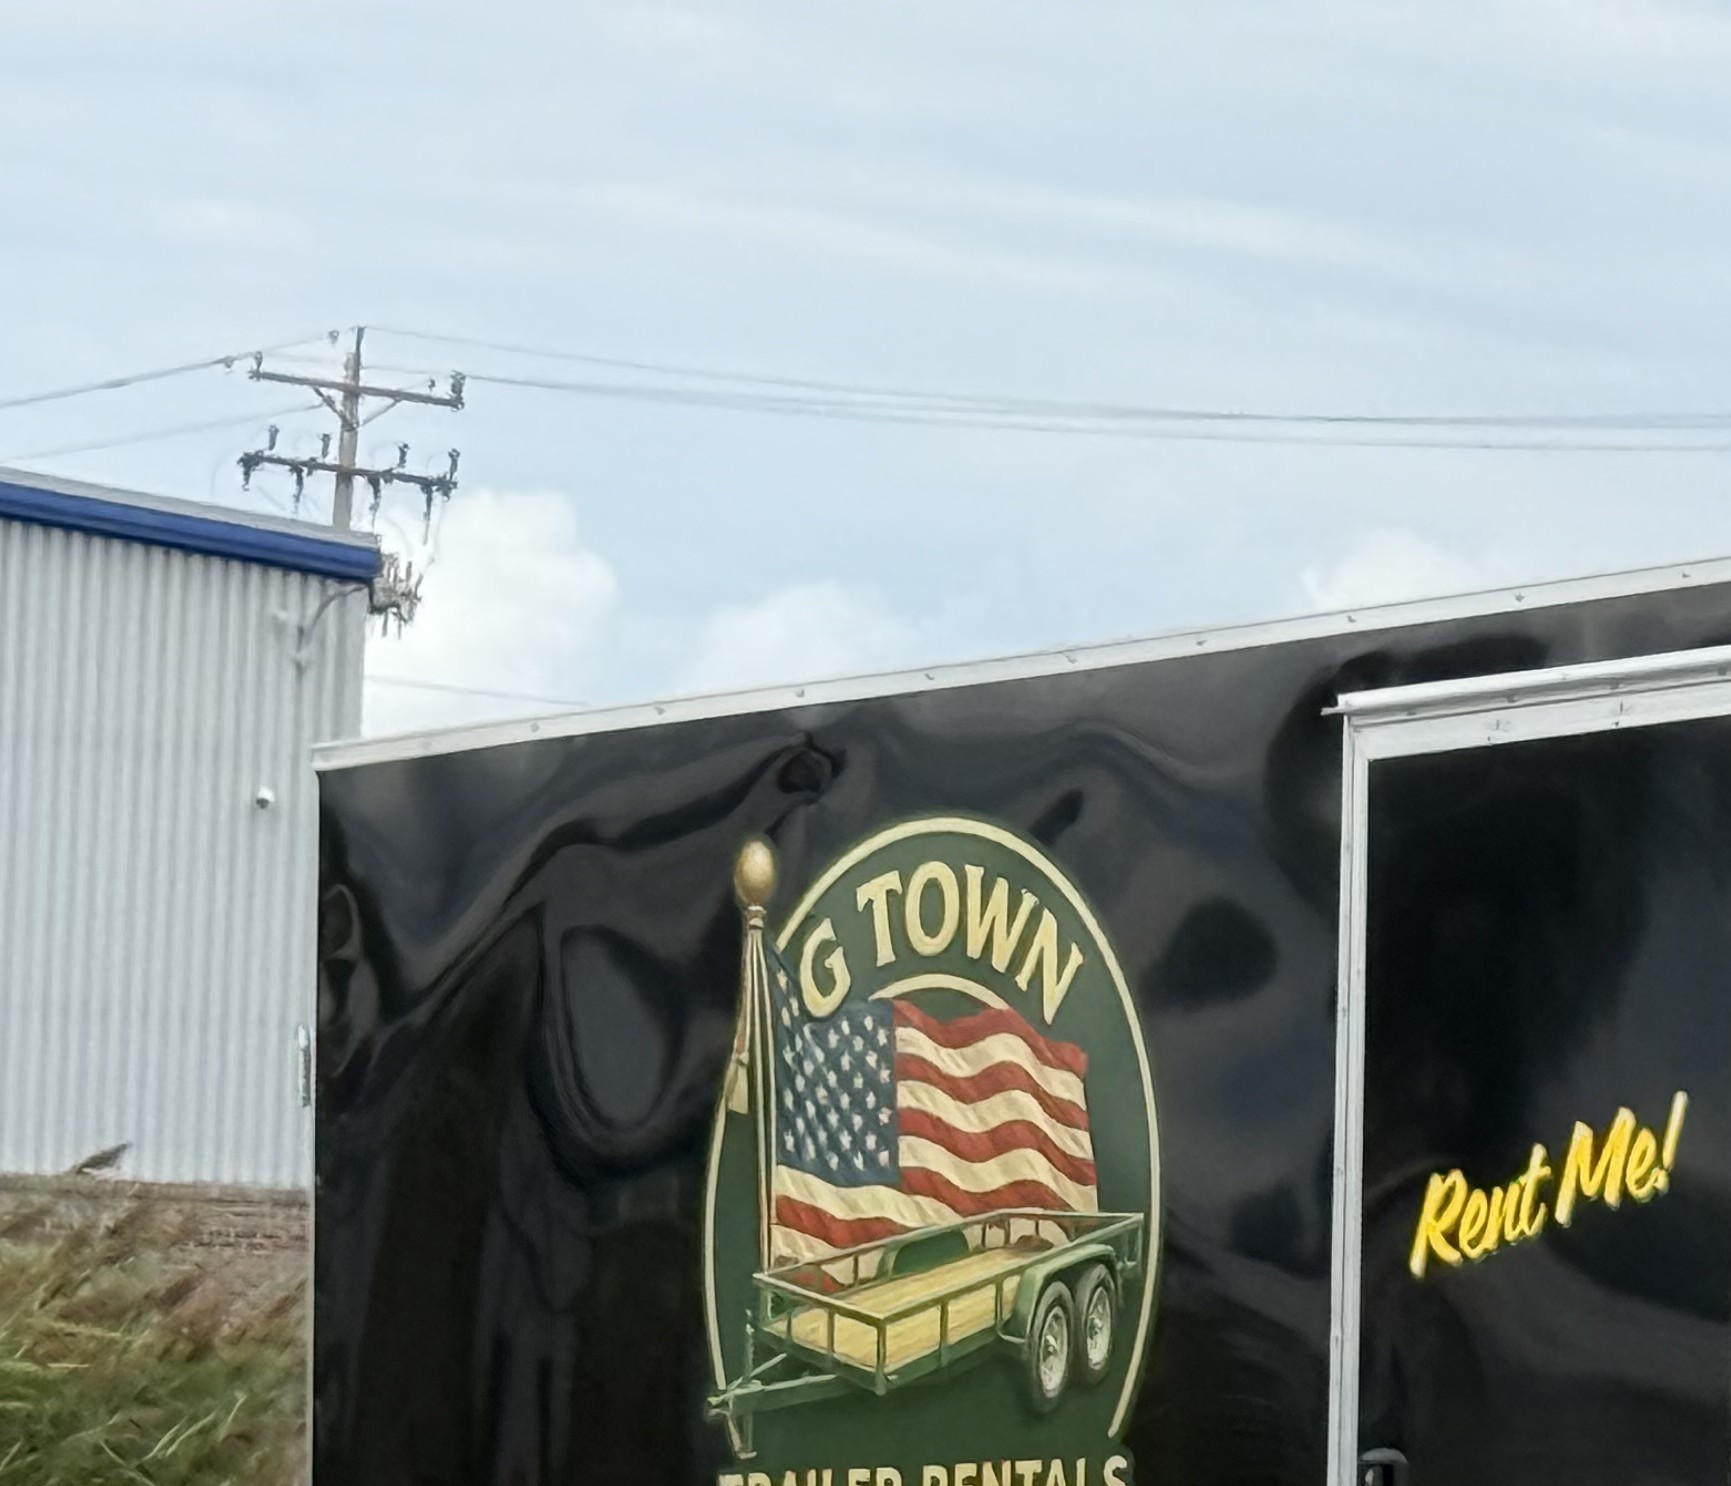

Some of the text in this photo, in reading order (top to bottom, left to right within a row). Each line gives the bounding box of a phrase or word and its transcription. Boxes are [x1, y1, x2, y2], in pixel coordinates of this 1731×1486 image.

[799, 860, 1084, 1026] G TOWN
[1408, 1089, 1689, 1279] Rent Me!
